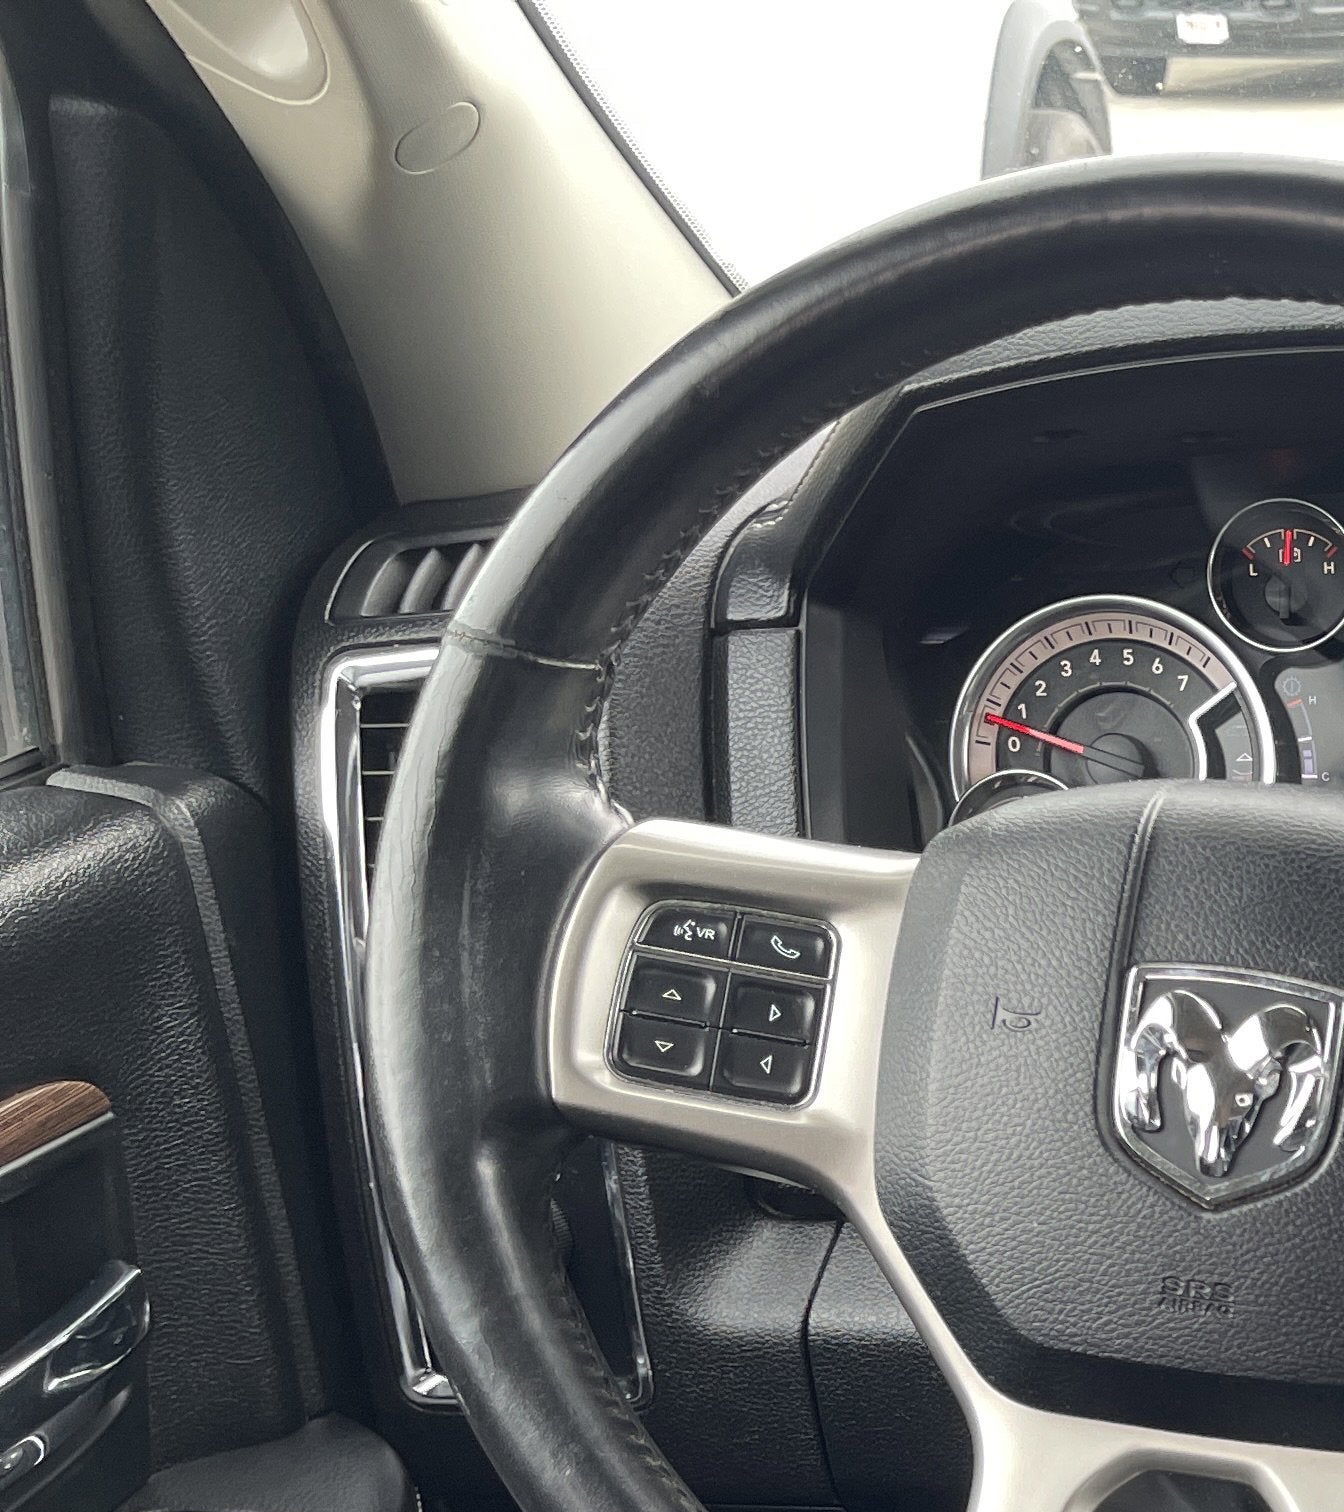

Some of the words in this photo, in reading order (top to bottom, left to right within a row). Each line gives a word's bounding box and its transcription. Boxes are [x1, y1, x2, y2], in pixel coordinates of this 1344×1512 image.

[1249, 563, 1258, 577] L
[1323, 561, 1335, 575] H
[1089, 648, 1102, 666] 4
[1122, 648, 1134, 666] 5
[1151, 657, 1164, 675] 6
[1060, 659, 1073, 677] 3
[1034, 679, 1048, 697] 2
[1177, 674, 1189, 692] 7
[1017, 703, 1027, 720] 1
[1007, 736, 1021, 753] 0
[696, 926, 716, 941] VR
